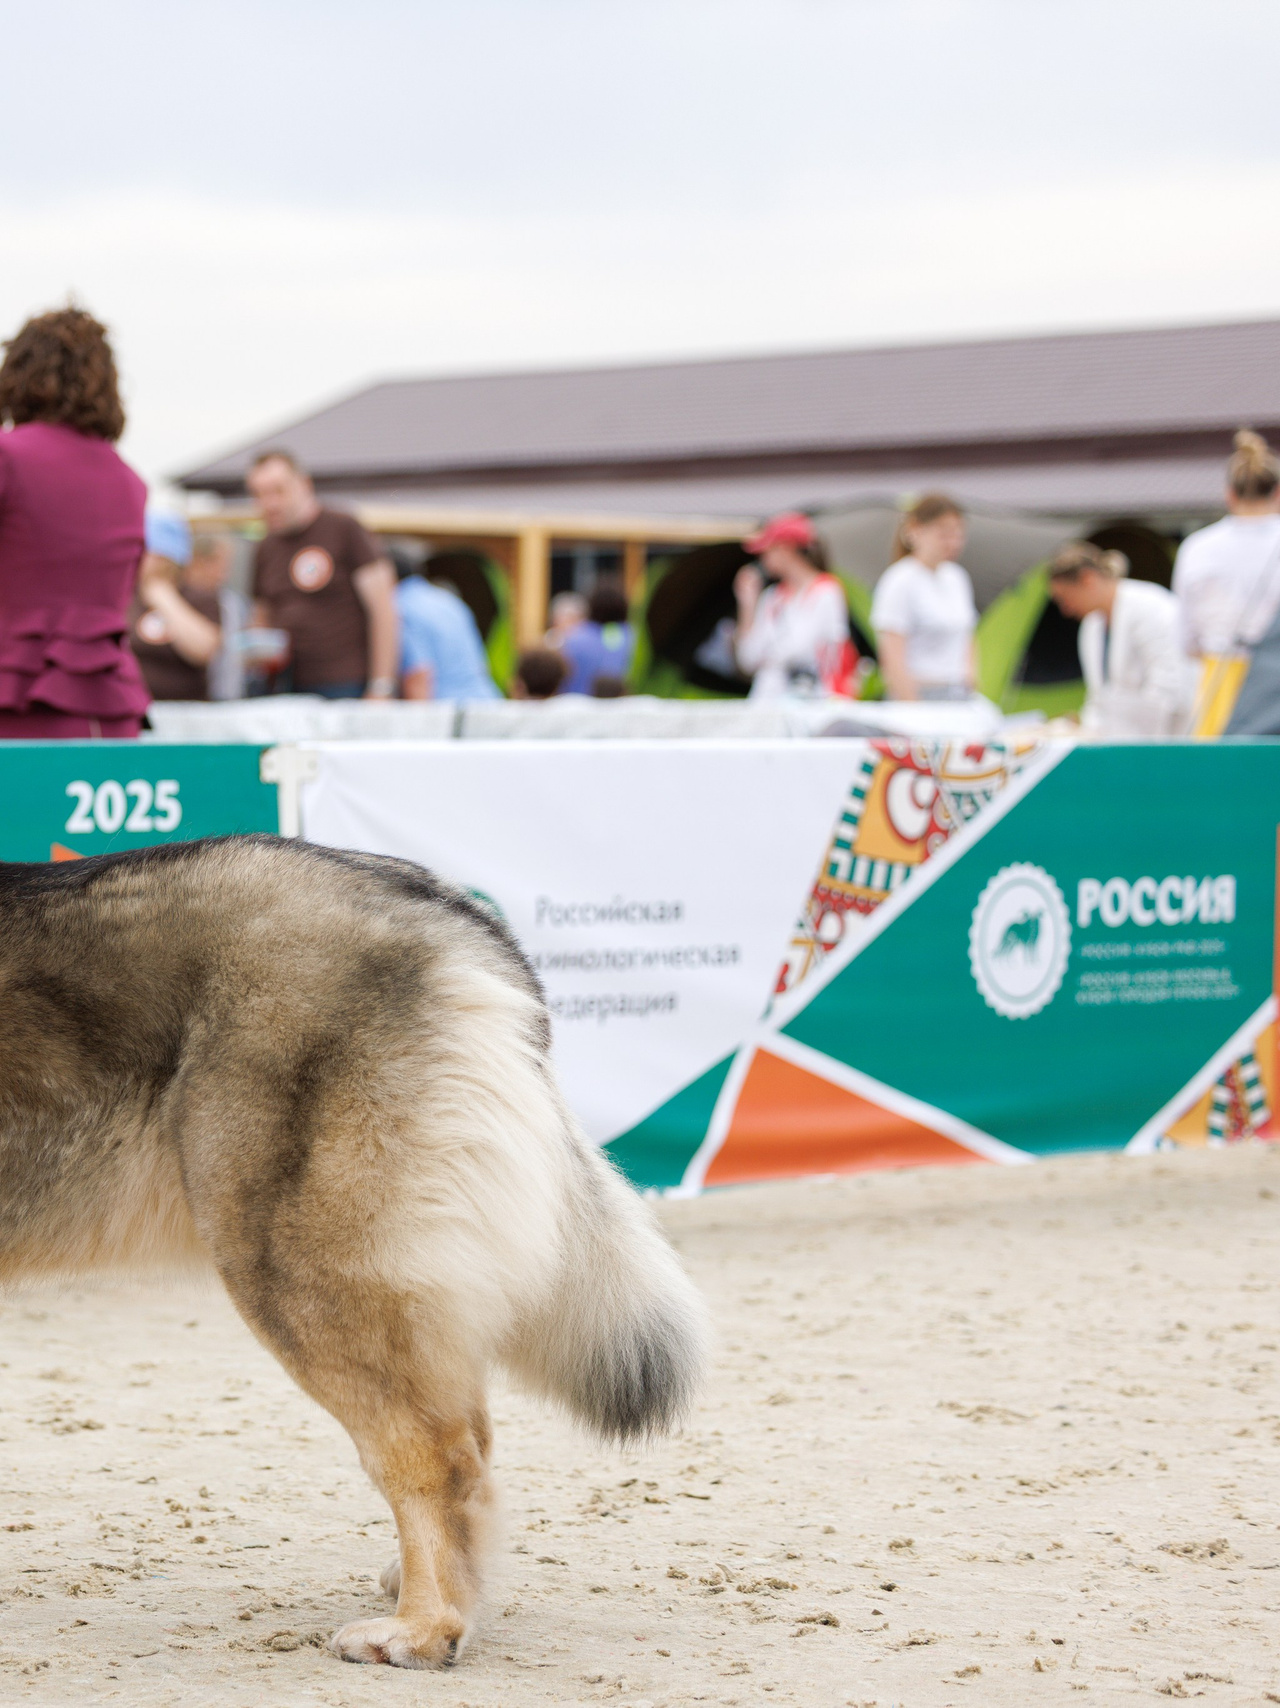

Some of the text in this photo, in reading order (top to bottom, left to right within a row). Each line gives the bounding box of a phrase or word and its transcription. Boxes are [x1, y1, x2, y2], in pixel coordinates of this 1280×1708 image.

[65, 779, 183, 833] 2025
[535, 893, 684, 927] Российская
[1077, 874, 1236, 929] РОССИЯ
[549, 991, 678, 1023] едерация
